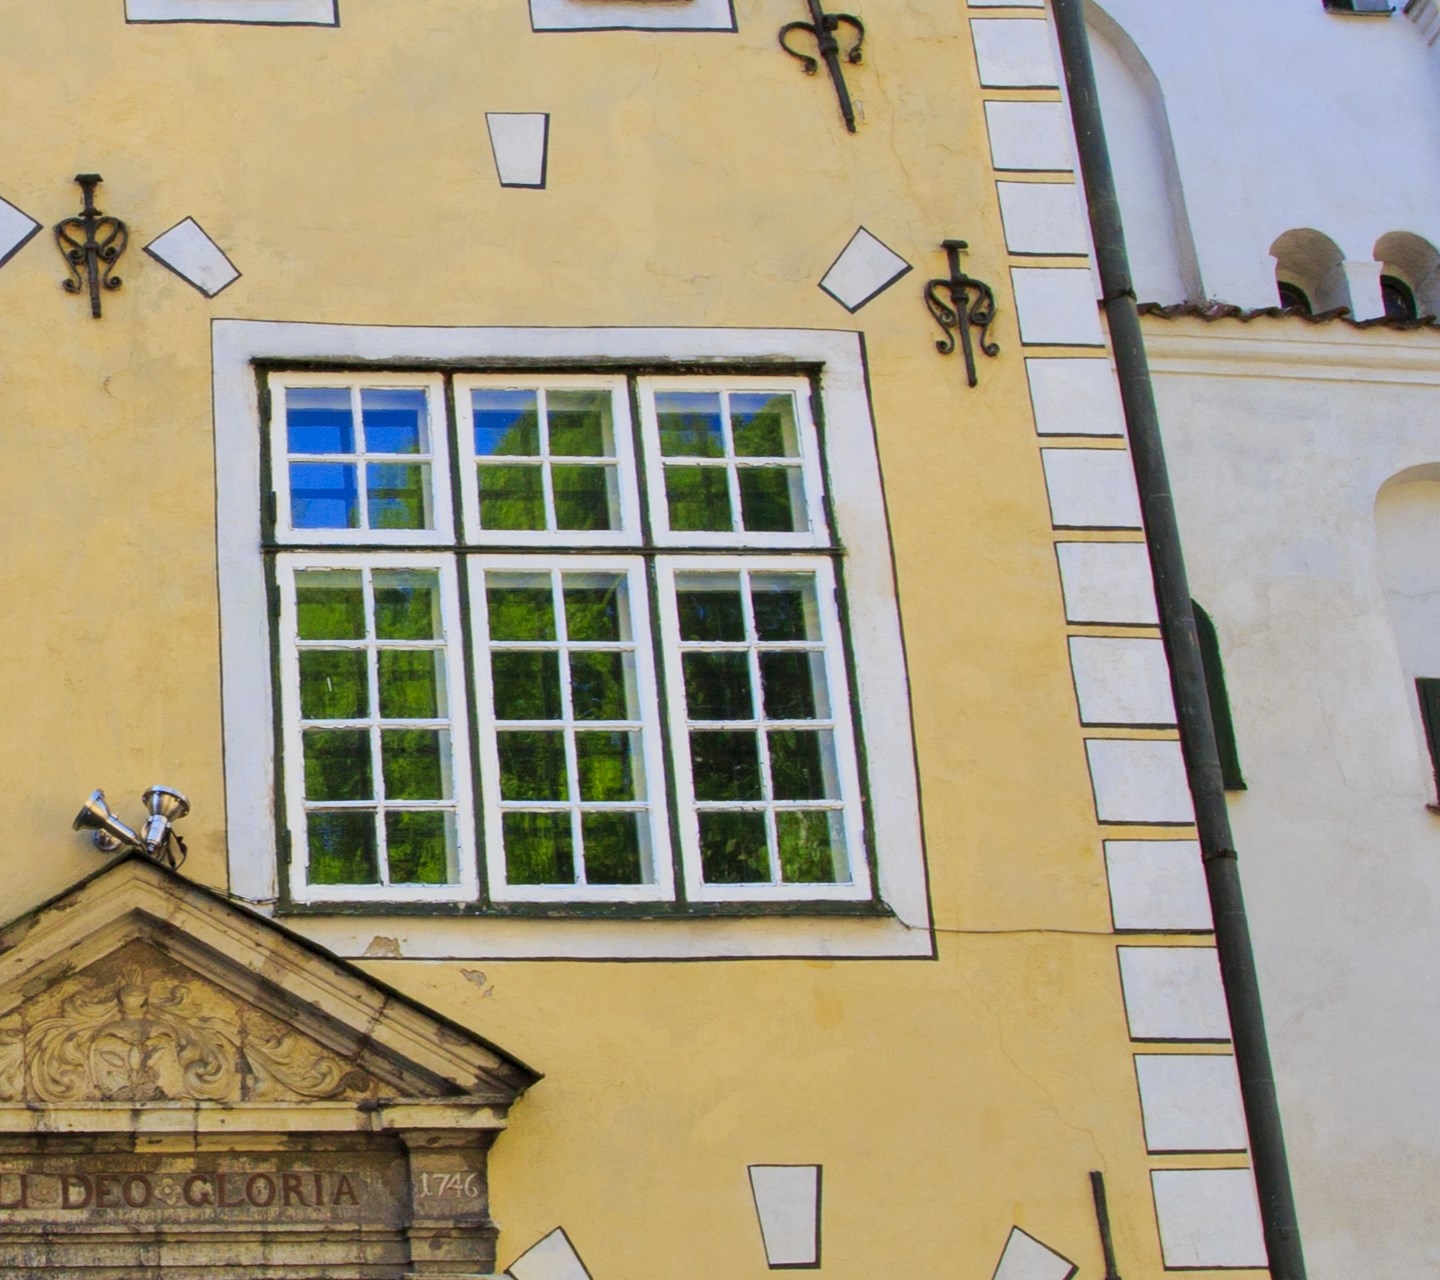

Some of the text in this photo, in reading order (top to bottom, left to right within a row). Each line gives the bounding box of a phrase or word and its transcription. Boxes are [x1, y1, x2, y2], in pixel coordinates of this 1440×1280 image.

[58, 1172, 154, 1210] DEO
[182, 1171, 361, 1208] GLORIA
[419, 1172, 480, 1199] 1746
